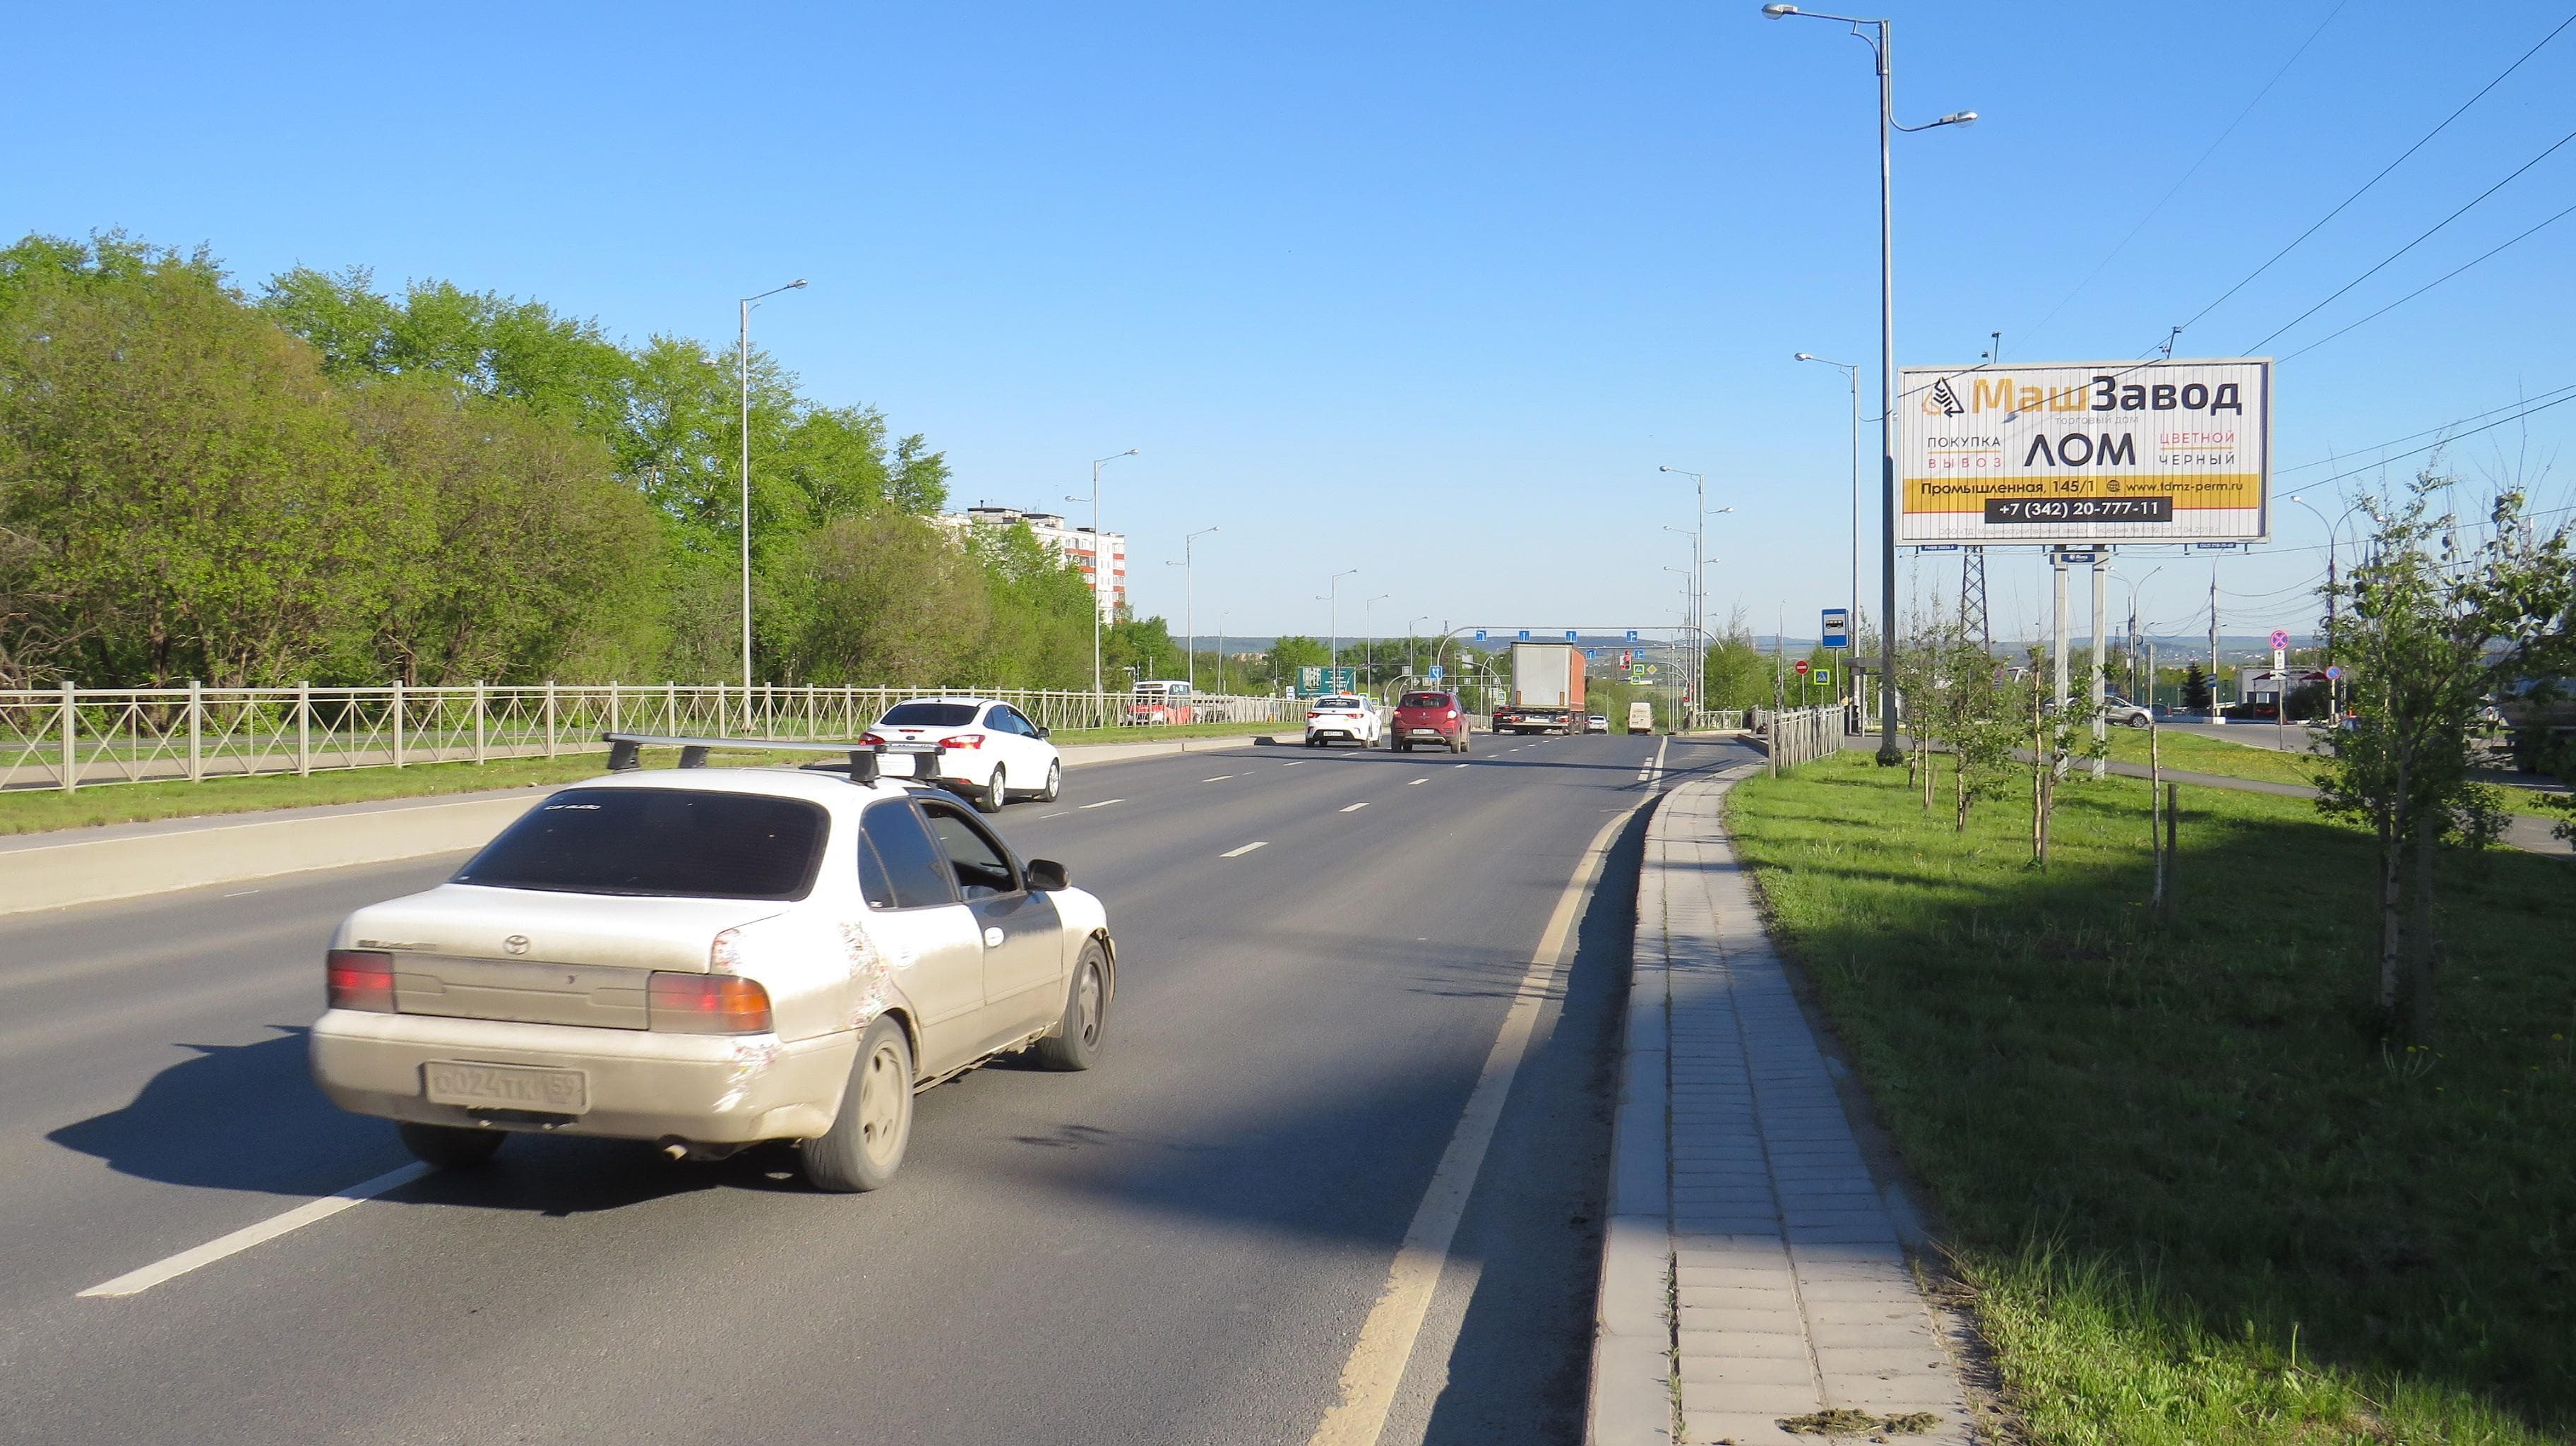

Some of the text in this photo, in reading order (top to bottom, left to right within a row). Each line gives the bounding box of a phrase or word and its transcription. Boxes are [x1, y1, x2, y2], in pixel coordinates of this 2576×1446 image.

[1972, 376, 2242, 417] МашЗавод
[2055, 415, 2139, 425] торговый дом
[1928, 436, 2001, 448] ПОКУПКА
[2159, 429, 2235, 445] ЦВЕТНОЙ
[2024, 432, 2136, 467] ЛОМ
[1928, 457, 2002, 469] ВЫВОЗ
[2159, 451, 2235, 466] ЧЕРНЫЙ
[1921, 480, 2094, 496] Промышленная, 145/1
[2125, 481, 2243, 494] www.tdmz-perm.ru
[1998, 501, 2158, 519] +7 (342) 20-777-11
